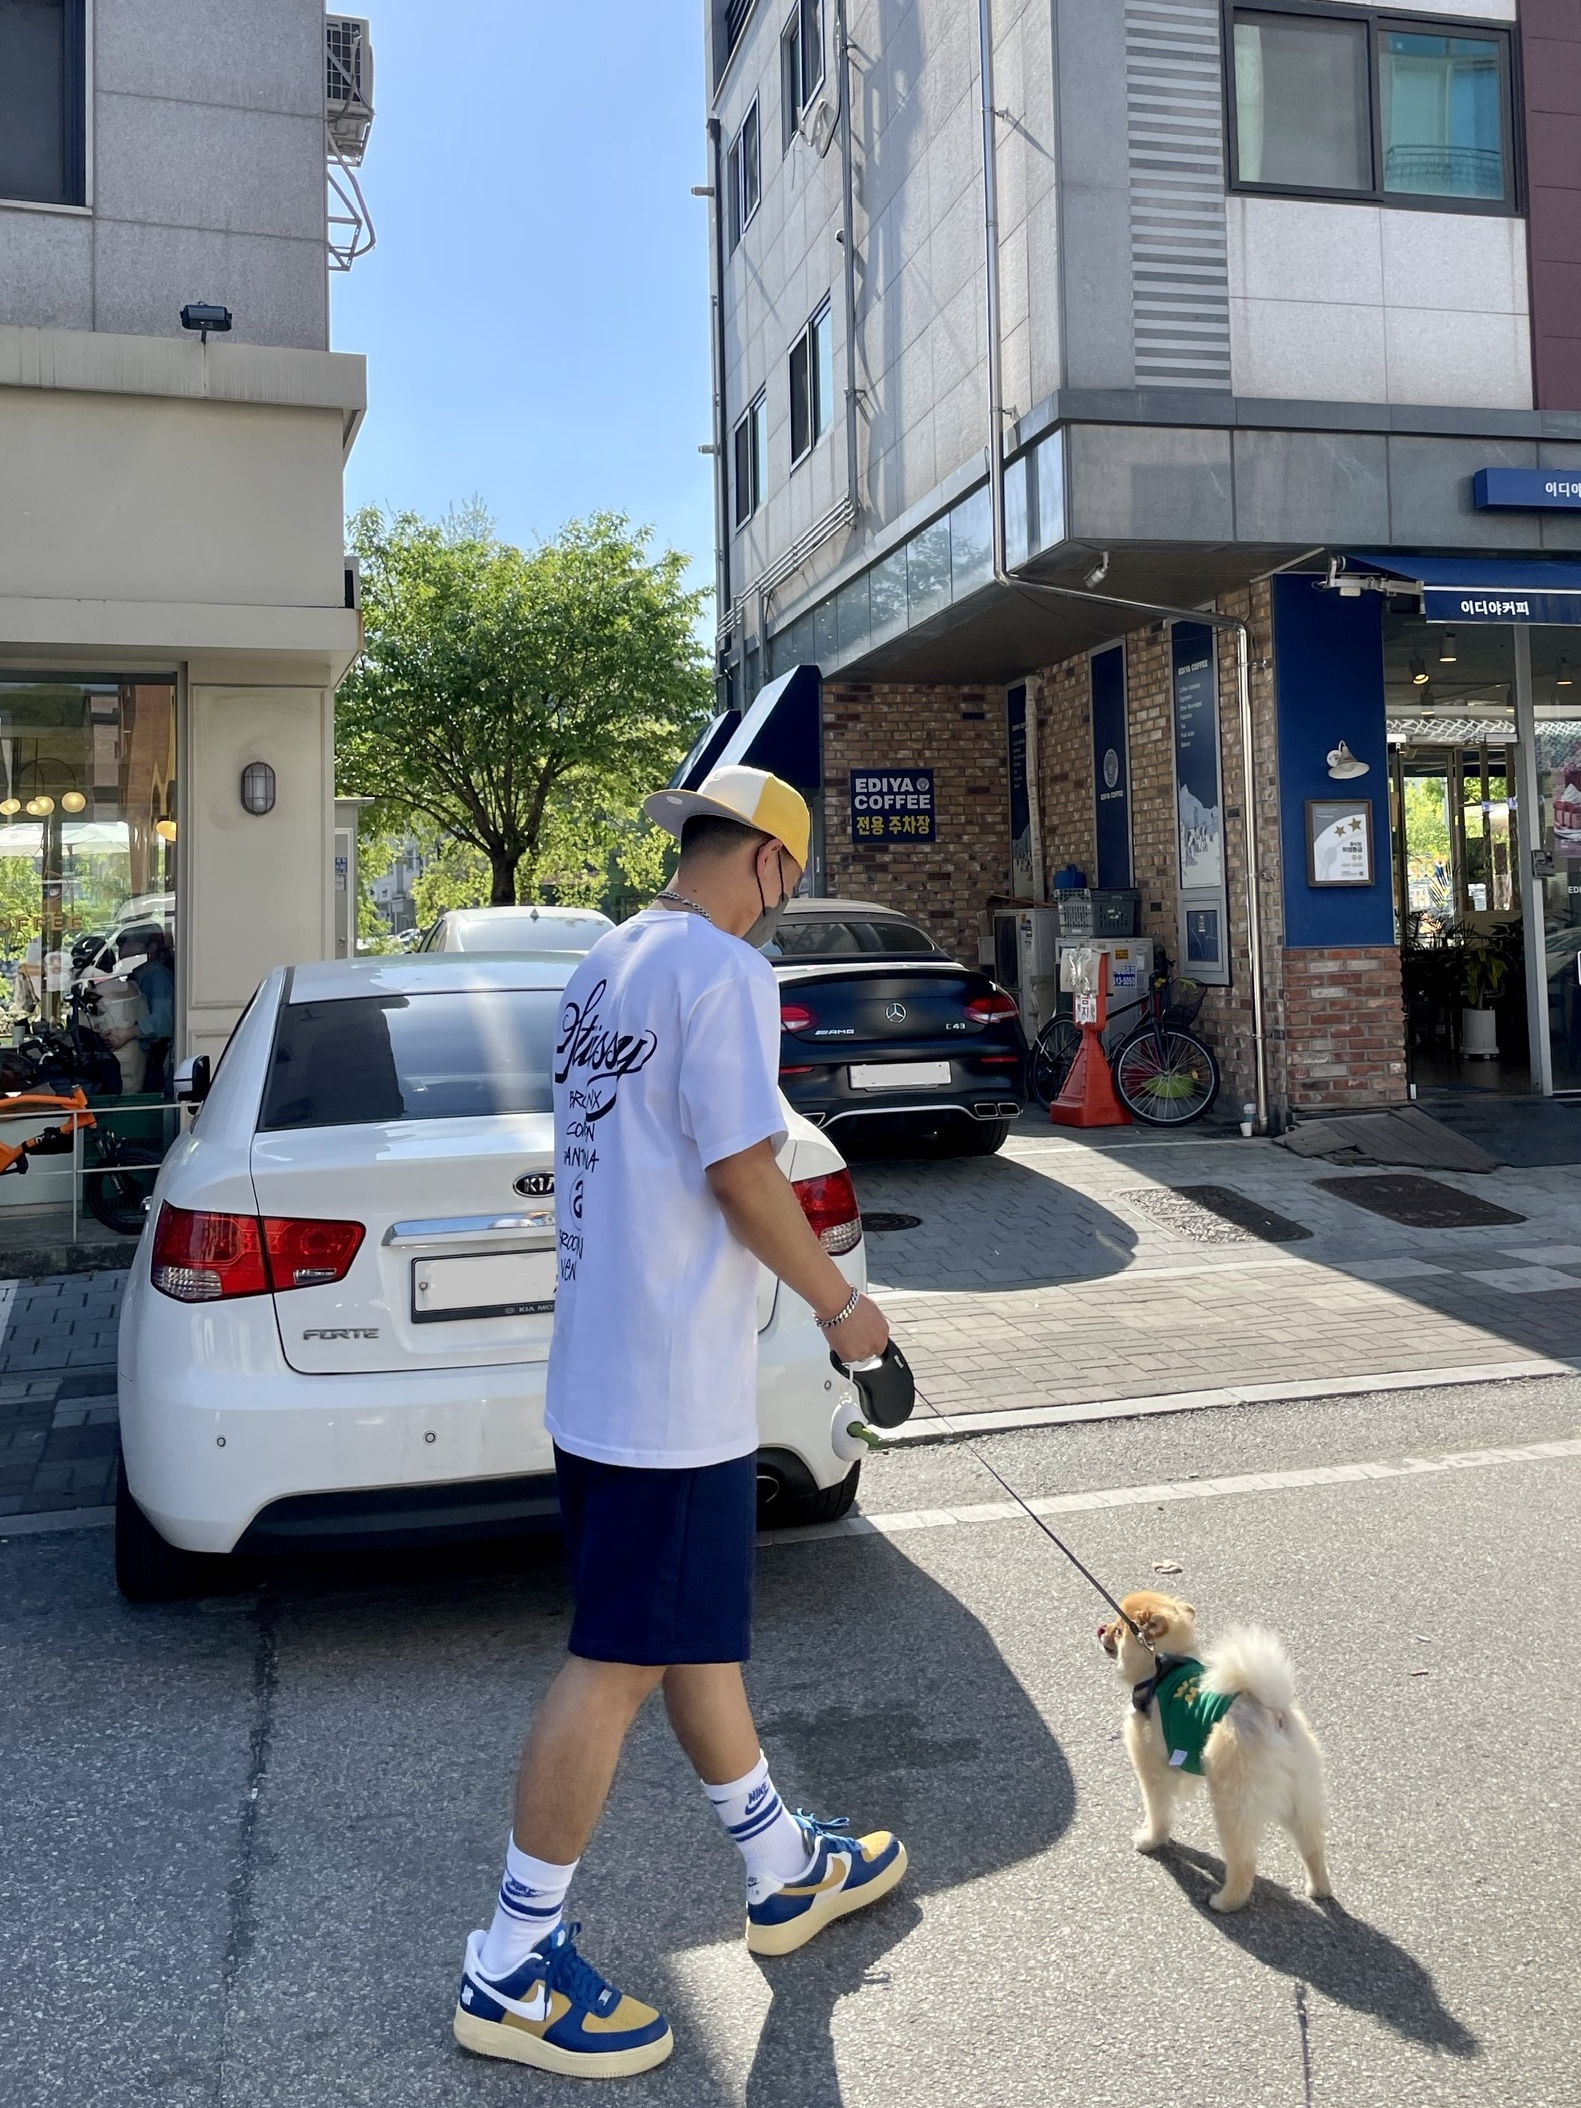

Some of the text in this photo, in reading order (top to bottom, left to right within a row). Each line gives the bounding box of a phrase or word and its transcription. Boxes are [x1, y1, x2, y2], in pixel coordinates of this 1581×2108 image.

[1461, 600, 1530, 616] 이디야커피
[1191, 659, 1208, 672] COFFEE
[855, 778, 914, 792] EDIYA
[854, 795, 931, 809] COFFEE
[856, 815, 930, 835] 전용 주차장
[303, 1328, 380, 1340] FORTE
[747, 1781, 768, 1805] NIKE
